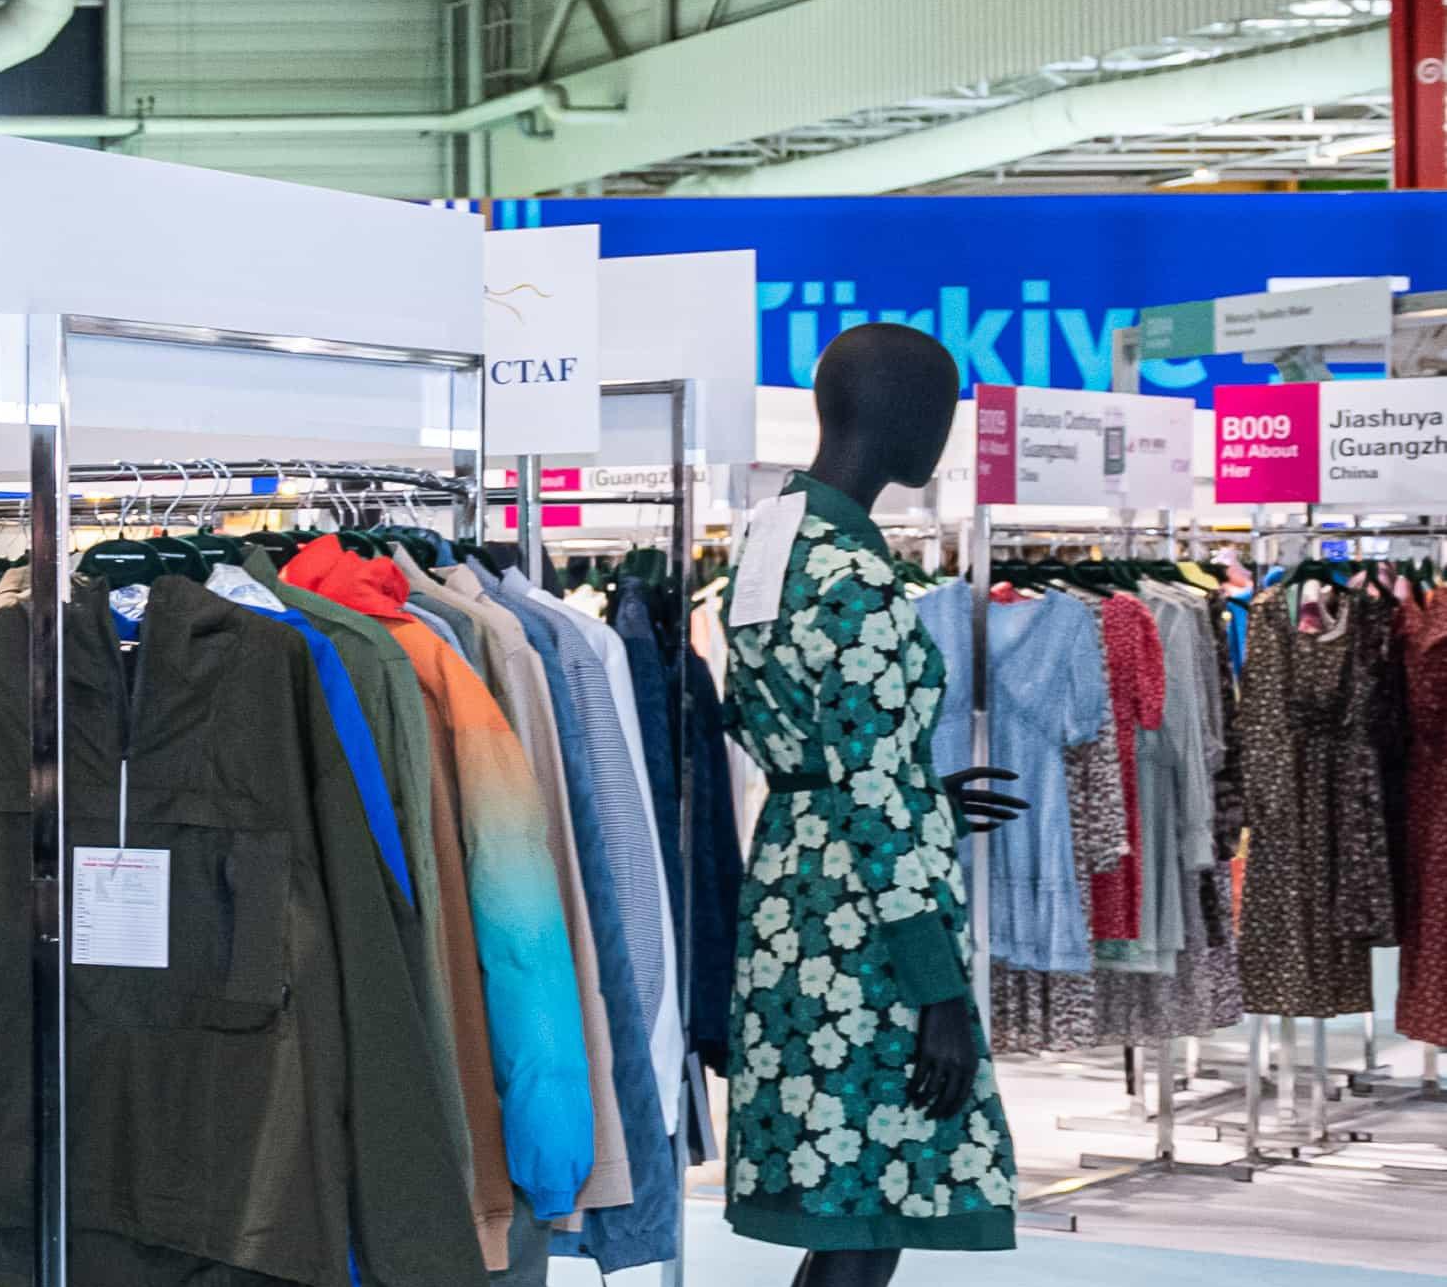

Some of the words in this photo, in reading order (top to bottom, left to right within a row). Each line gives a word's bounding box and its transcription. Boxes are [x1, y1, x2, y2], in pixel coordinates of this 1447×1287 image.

[755, 280, 1207, 392] ükiy
[490, 357, 578, 385] CTAF
[1221, 415, 1291, 441] B009
[1329, 408, 1443, 430] Jiashuya
[1221, 444, 1245, 459] All
[1248, 443, 1299, 459] About
[1330, 436, 1447, 460] (Guangzh
[1221, 464, 1252, 479] Her
[1330, 466, 1379, 480] China
